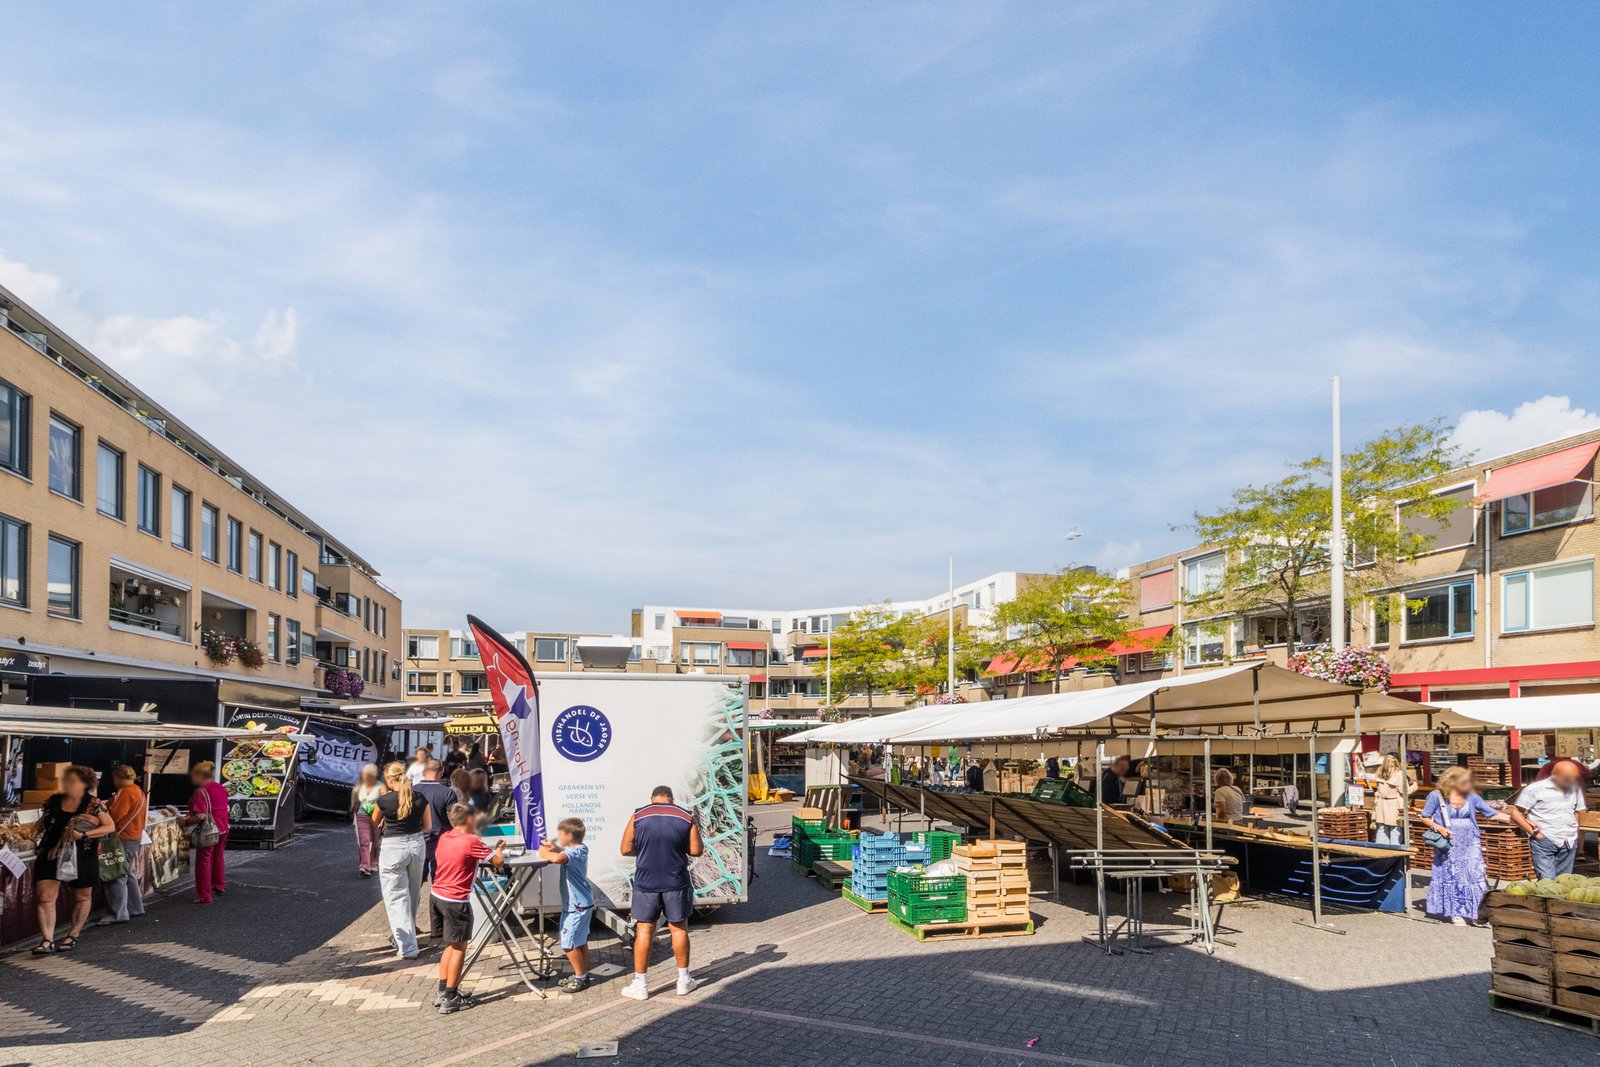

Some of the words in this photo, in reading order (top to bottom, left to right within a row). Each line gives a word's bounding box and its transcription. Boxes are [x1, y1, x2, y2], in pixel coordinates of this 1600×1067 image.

[252, 712, 300, 724] DELICATESSEN
[446, 725, 484, 733] WILLEM
[556, 709, 586, 743] VISHANDEL
[590, 711, 600, 720] DE
